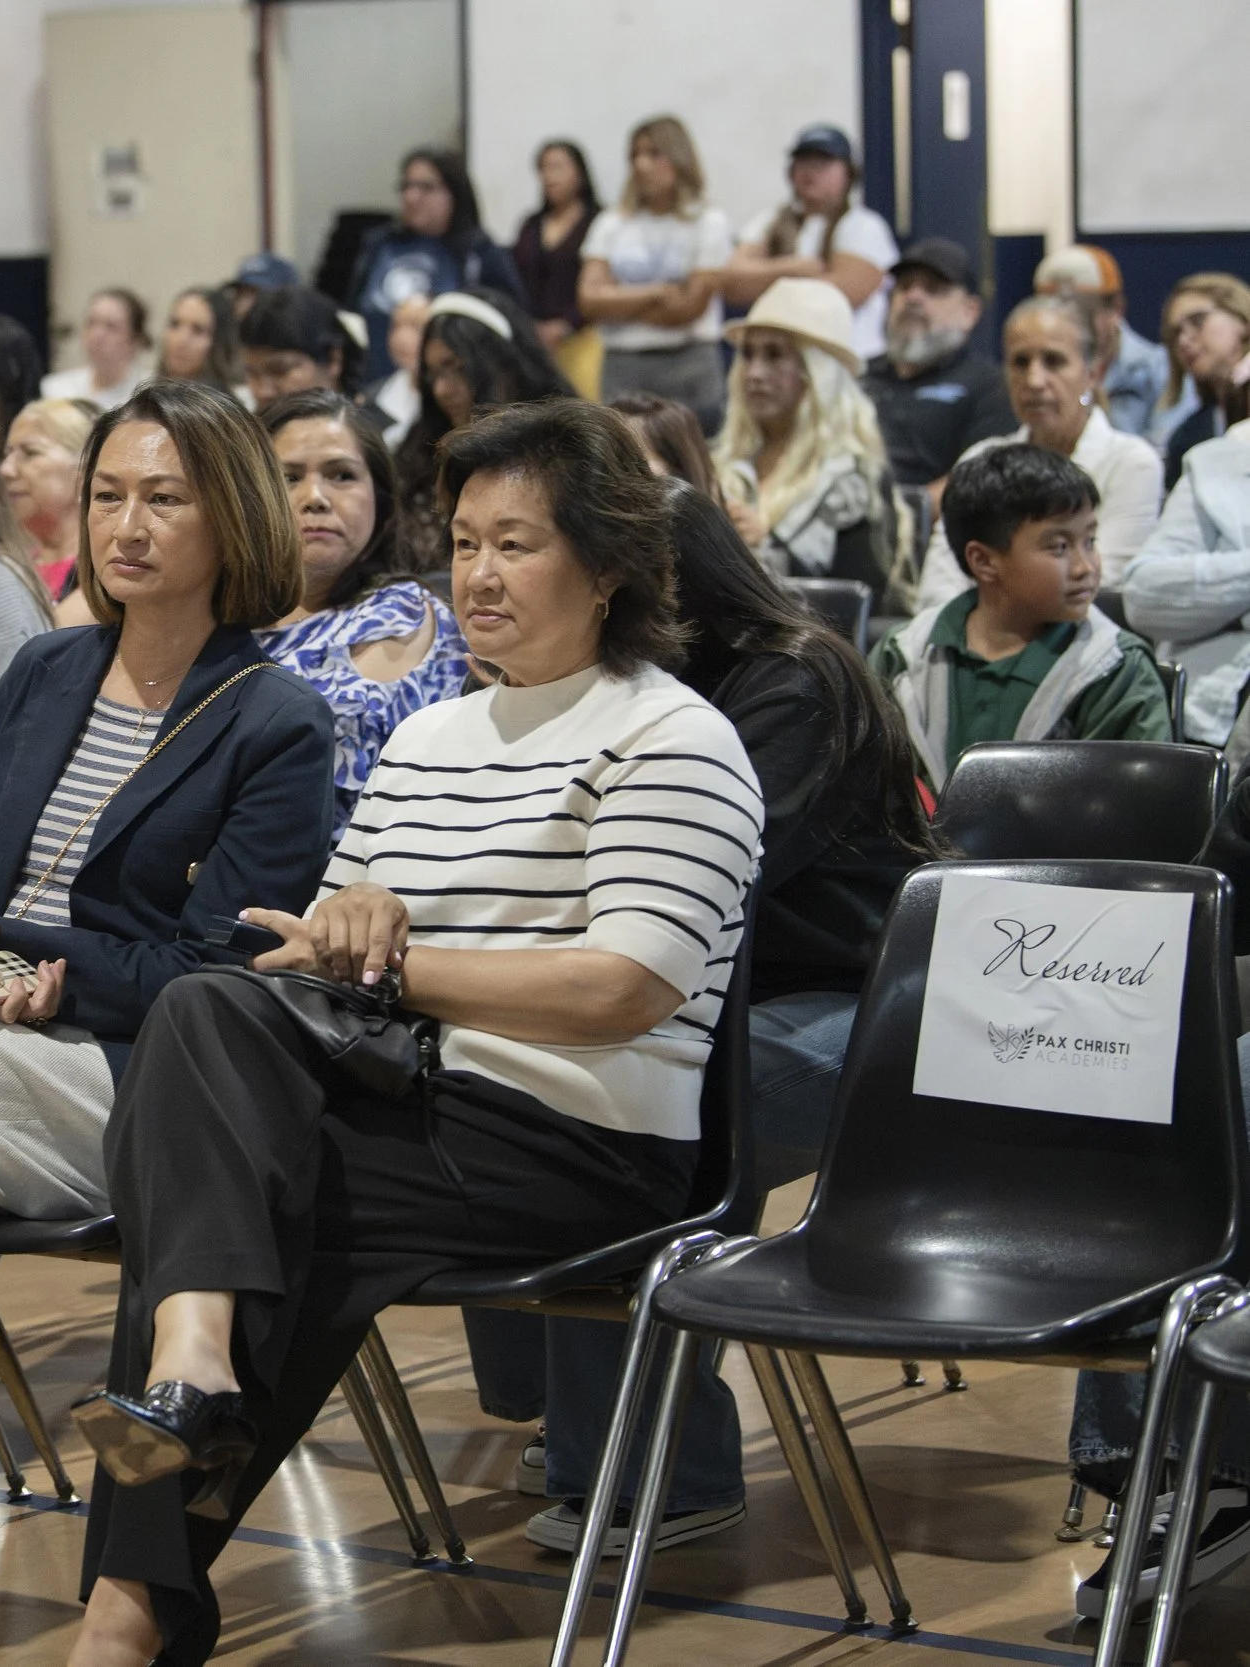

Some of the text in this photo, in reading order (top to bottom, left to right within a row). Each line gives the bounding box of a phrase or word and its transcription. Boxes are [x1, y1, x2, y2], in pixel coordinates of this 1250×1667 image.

[983, 918, 1165, 986] Reserved
[1036, 1034, 1131, 1056] PAX CHRISTI
[1034, 1050, 1130, 1072] ACADEMIES
